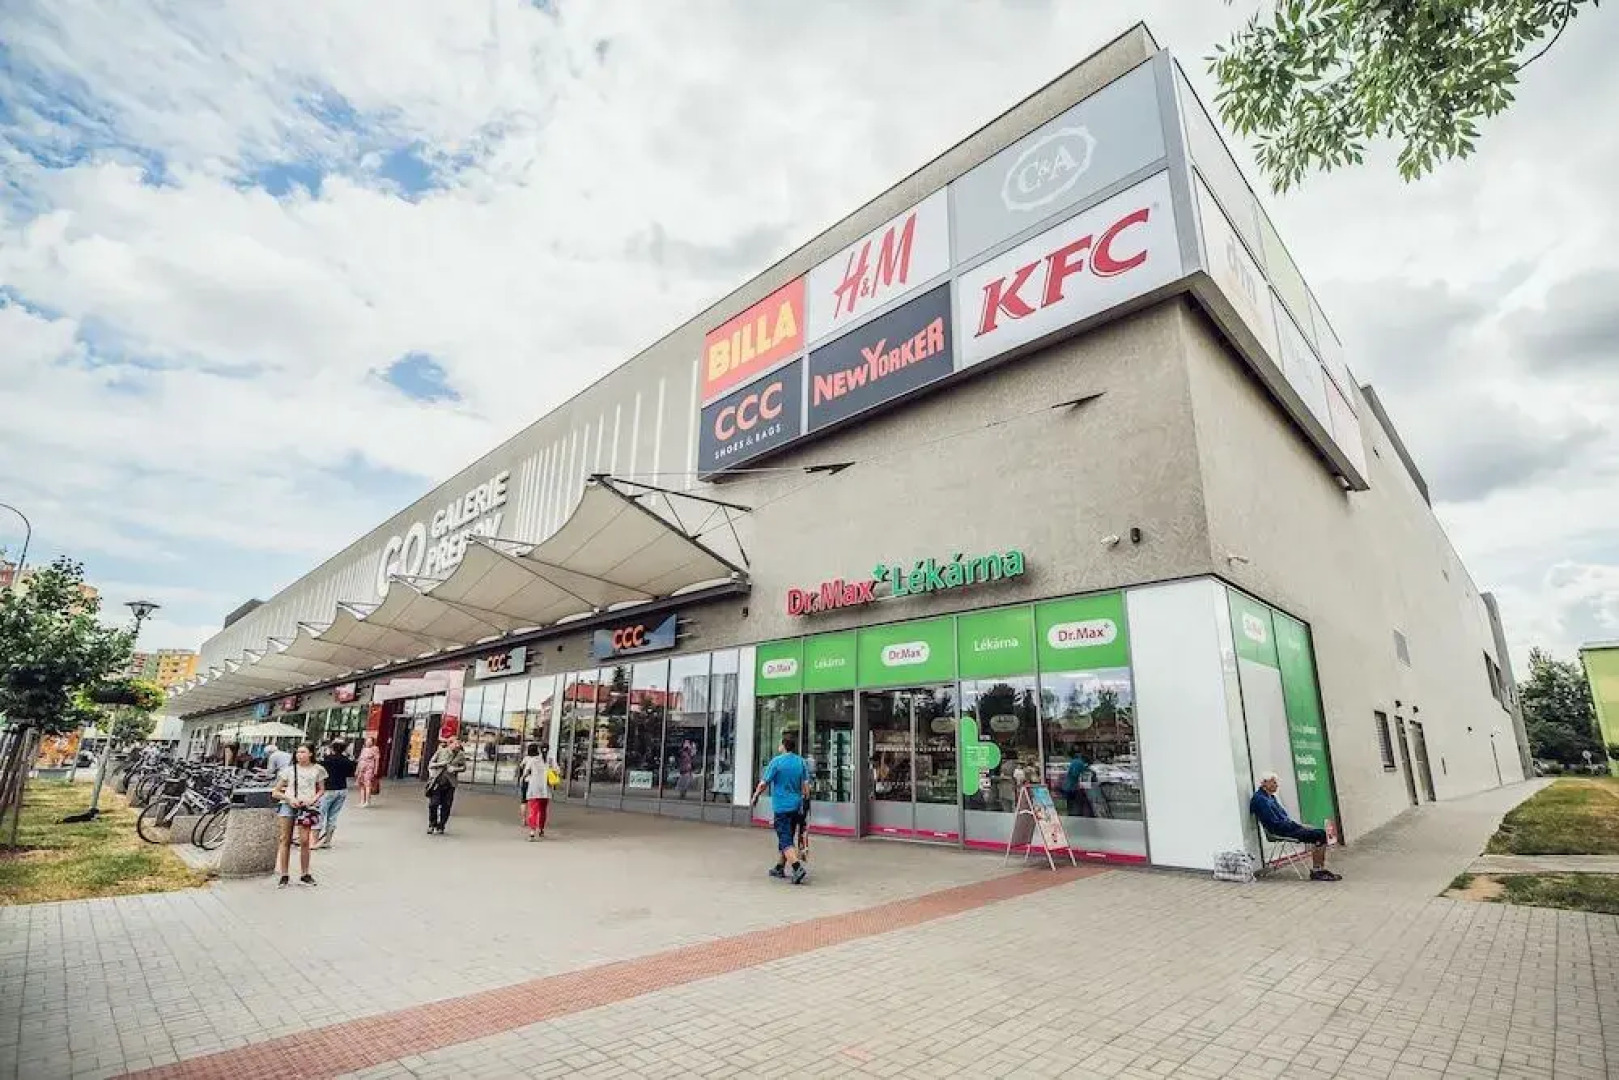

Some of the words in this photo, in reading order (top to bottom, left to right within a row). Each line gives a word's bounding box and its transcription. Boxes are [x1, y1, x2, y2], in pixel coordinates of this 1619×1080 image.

[1014, 142, 1076, 195] C&A
[833, 212, 916, 319] H&M
[974, 208, 1150, 338] KFC
[706, 300, 799, 382] BILLA
[715, 382, 782, 440] CCC
[715, 440, 744, 460] SHOES
[746, 435, 754, 446] &
[755, 424, 781, 442] BAGS
[431, 470, 510, 539] GALERIE
[787, 578, 875, 616] Dr.Max
[891, 547, 1025, 597] Lékárna
[612, 624, 645, 649] CCC
[973, 635, 1019, 652] Lékárna
[1058, 626, 1104, 642] Dr.Max
[487, 652, 506, 673] CCC
[766, 663, 791, 675] Dr.Max
[813, 655, 846, 669] Lékárna
[888, 645, 922, 660] Dr.Max
